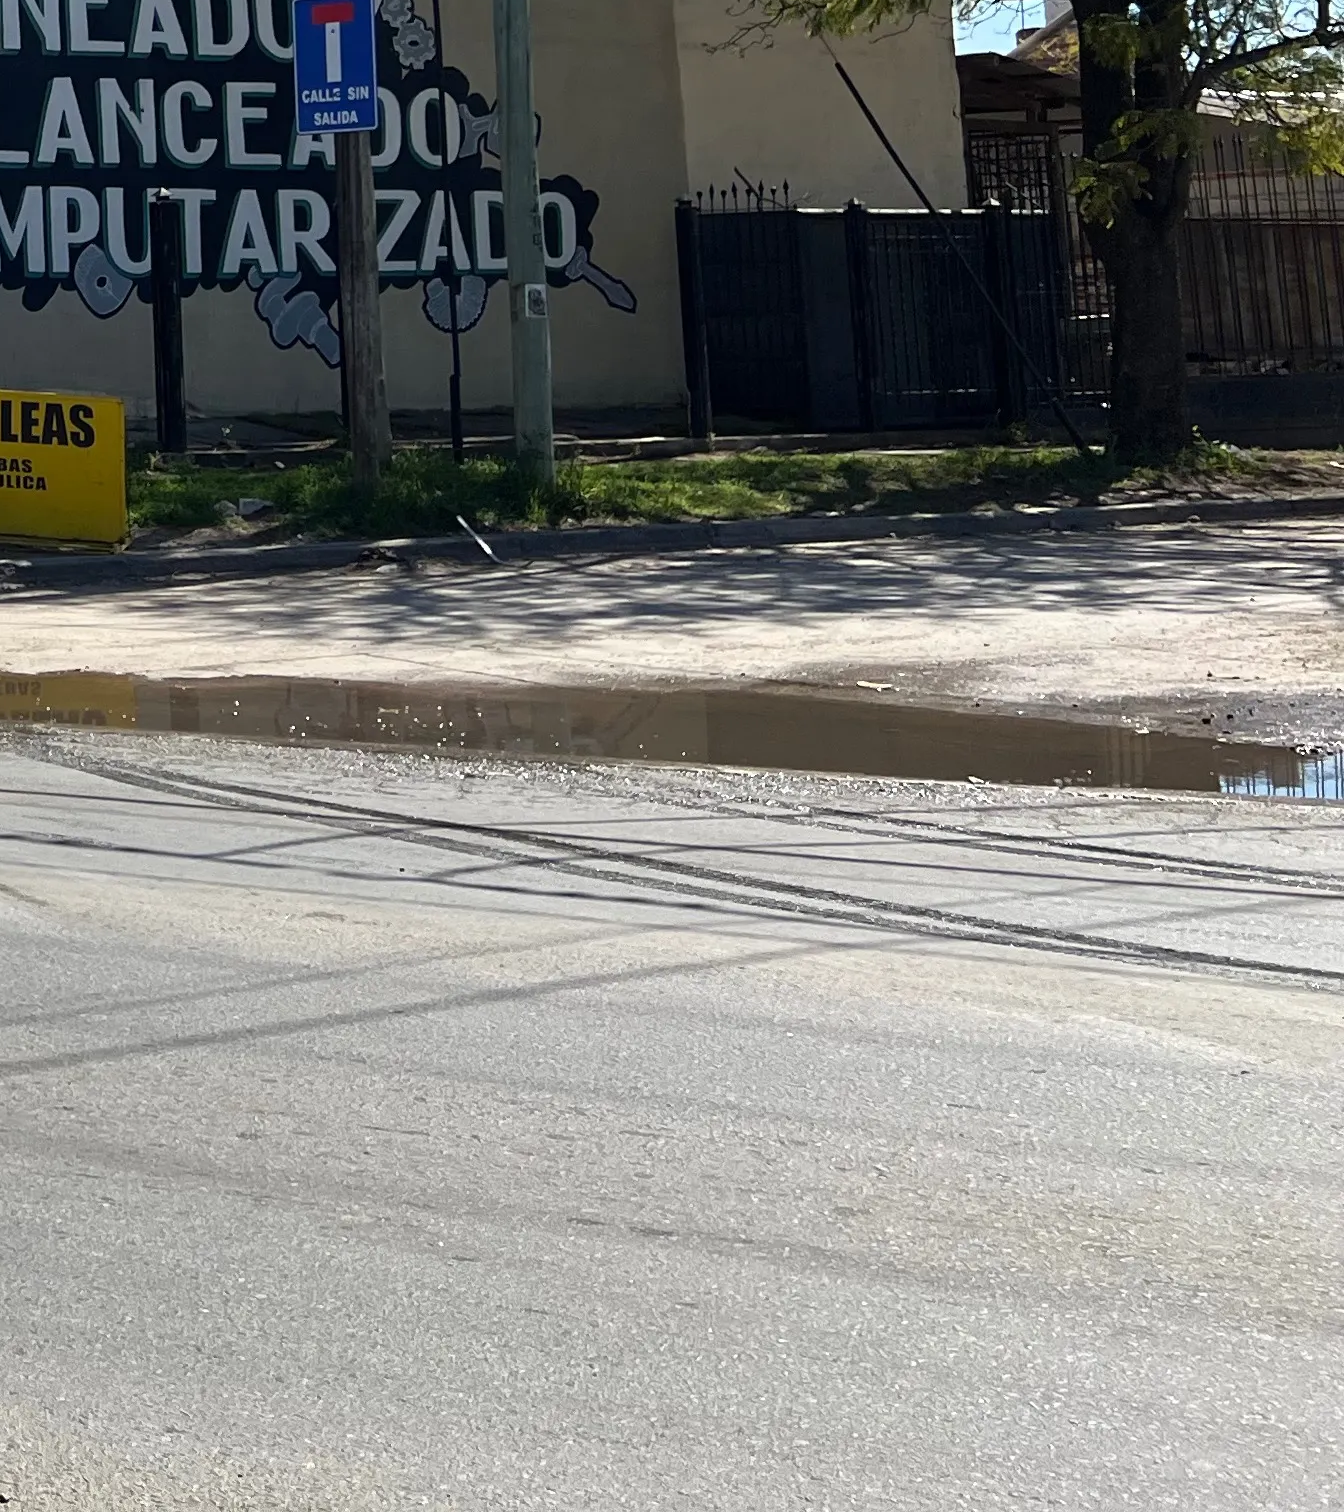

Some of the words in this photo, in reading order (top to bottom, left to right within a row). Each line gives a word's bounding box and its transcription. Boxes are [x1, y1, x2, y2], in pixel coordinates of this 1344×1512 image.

[302, 88, 342, 104] CALLE
[348, 86, 369, 100] SIN
[314, 110, 358, 126] SALIDA
